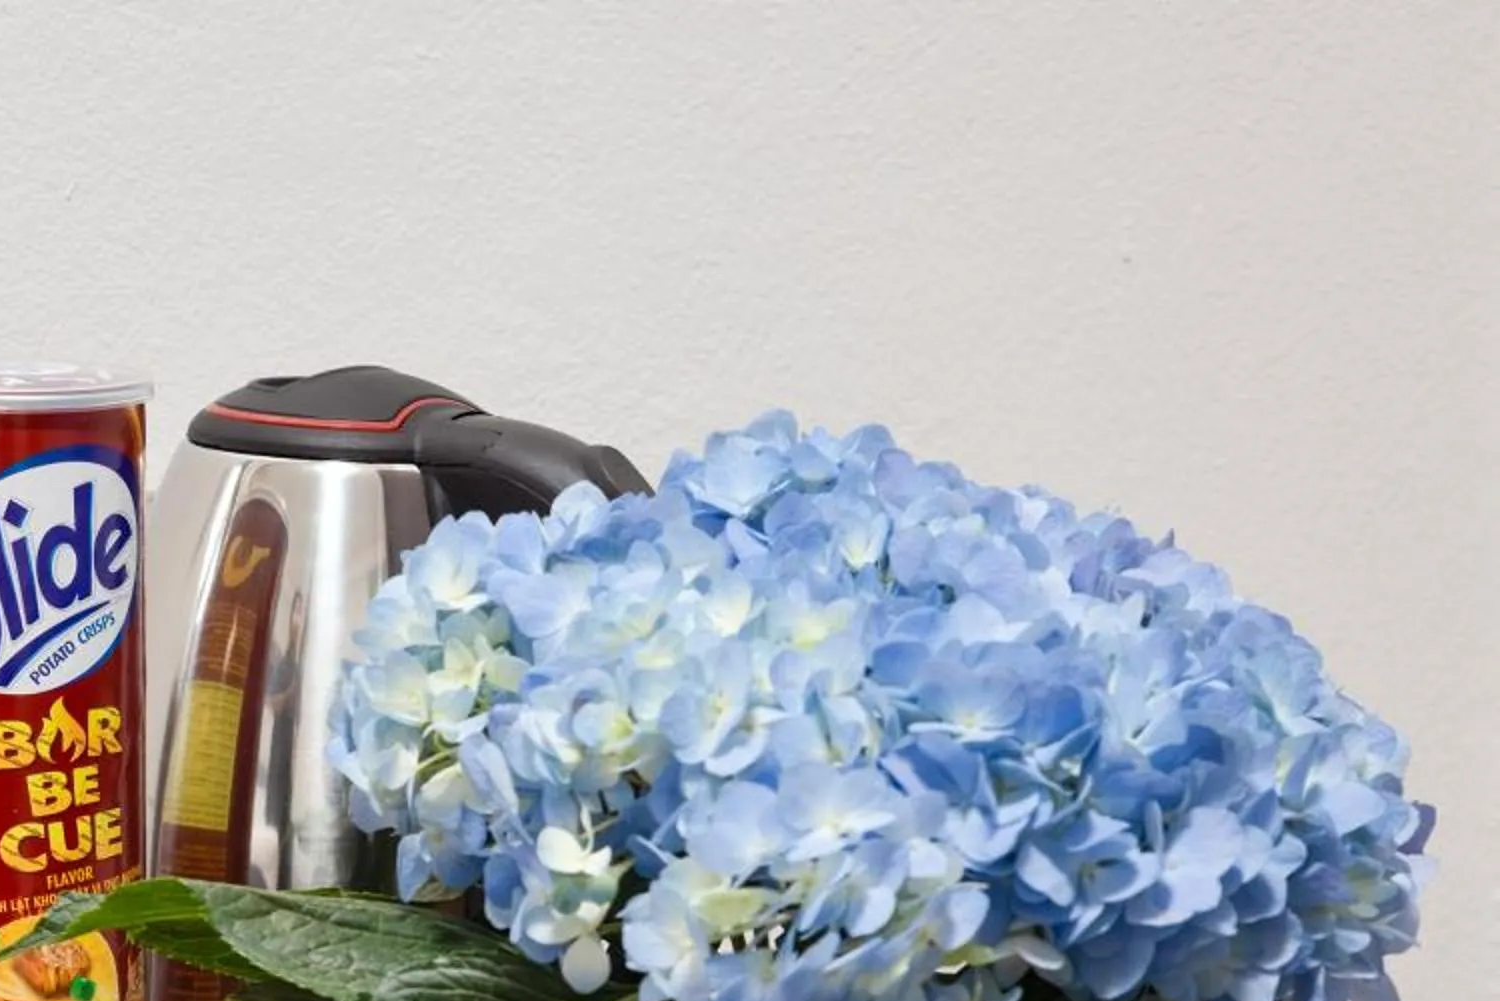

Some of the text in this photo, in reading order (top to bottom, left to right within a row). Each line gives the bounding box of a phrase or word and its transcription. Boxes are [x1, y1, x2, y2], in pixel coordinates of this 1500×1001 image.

[28, 611, 117, 685] POTATO CRISPS
[26, 764, 101, 817] BE
[0, 807, 123, 873] CUE
[33, 893, 58, 908] KHO
[46, 865, 93, 890] FLAVOR
